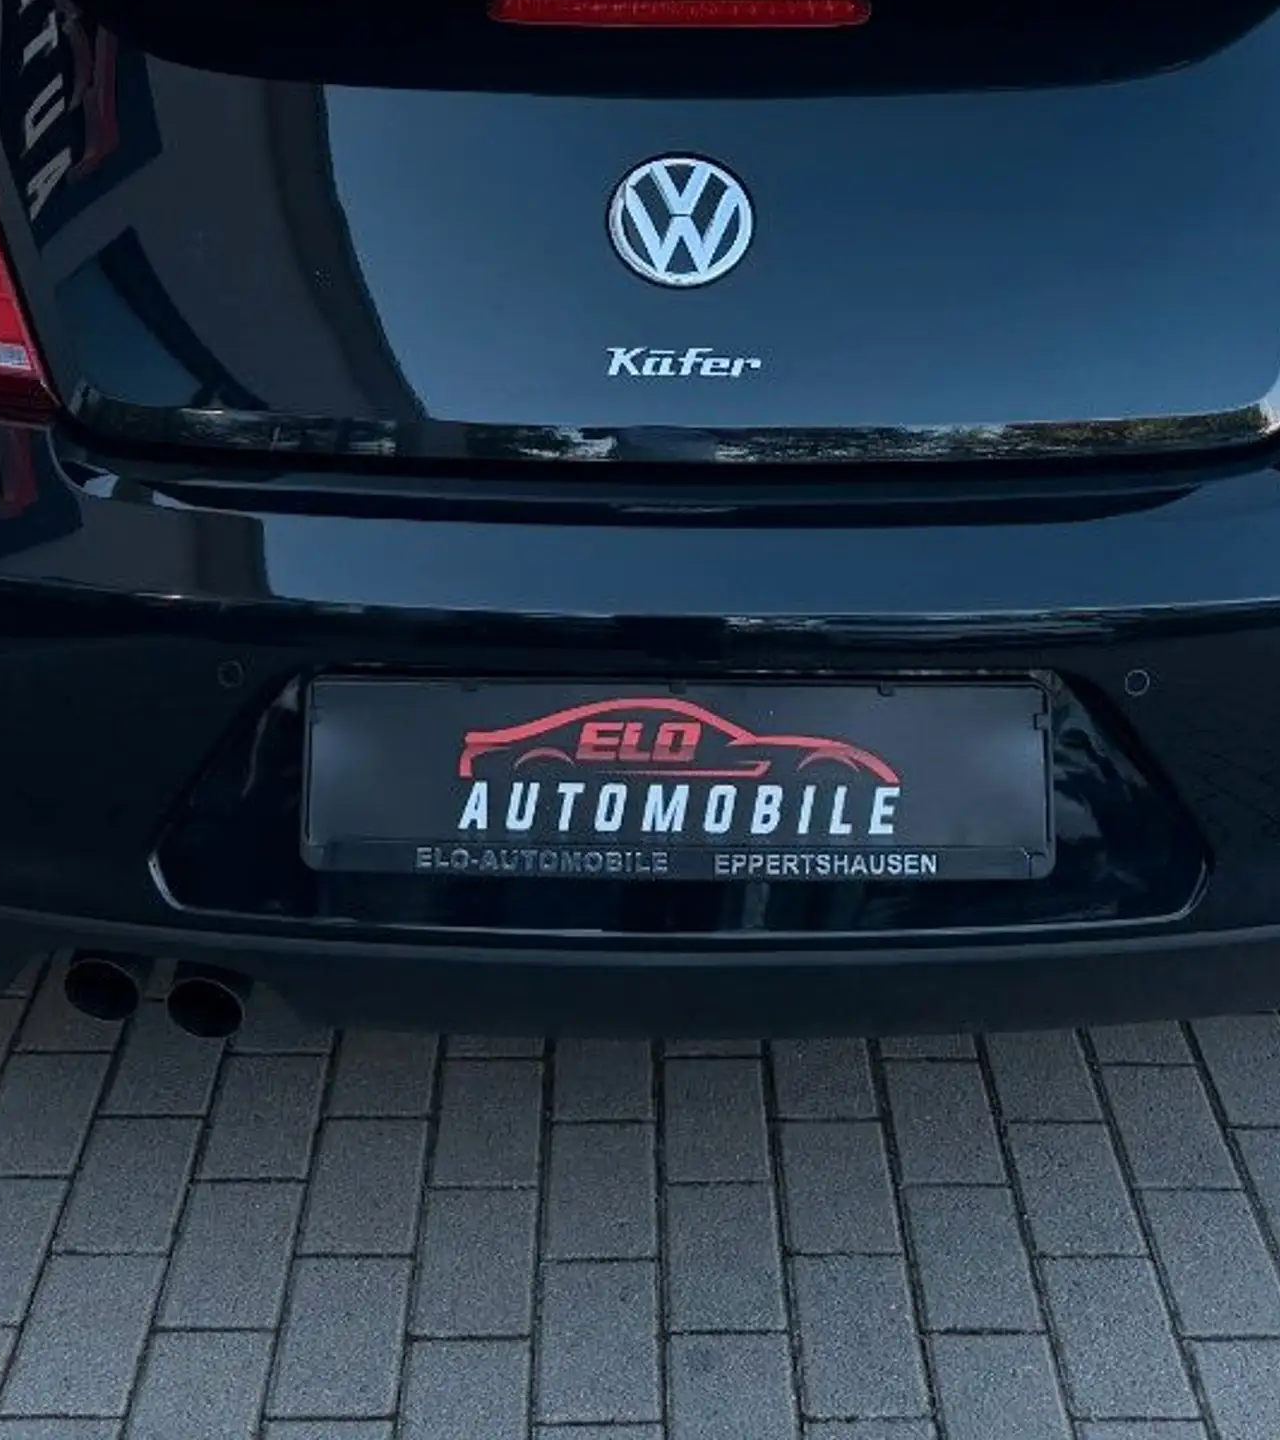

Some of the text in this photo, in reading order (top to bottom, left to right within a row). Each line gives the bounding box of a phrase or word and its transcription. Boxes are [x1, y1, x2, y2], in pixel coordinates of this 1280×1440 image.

[575, 722, 702, 761] ELO
[457, 781, 901, 835] AUTOMOBILE
[416, 846, 938, 876] ELO-AUTOMOBILE EPPERTSHAUSEN
